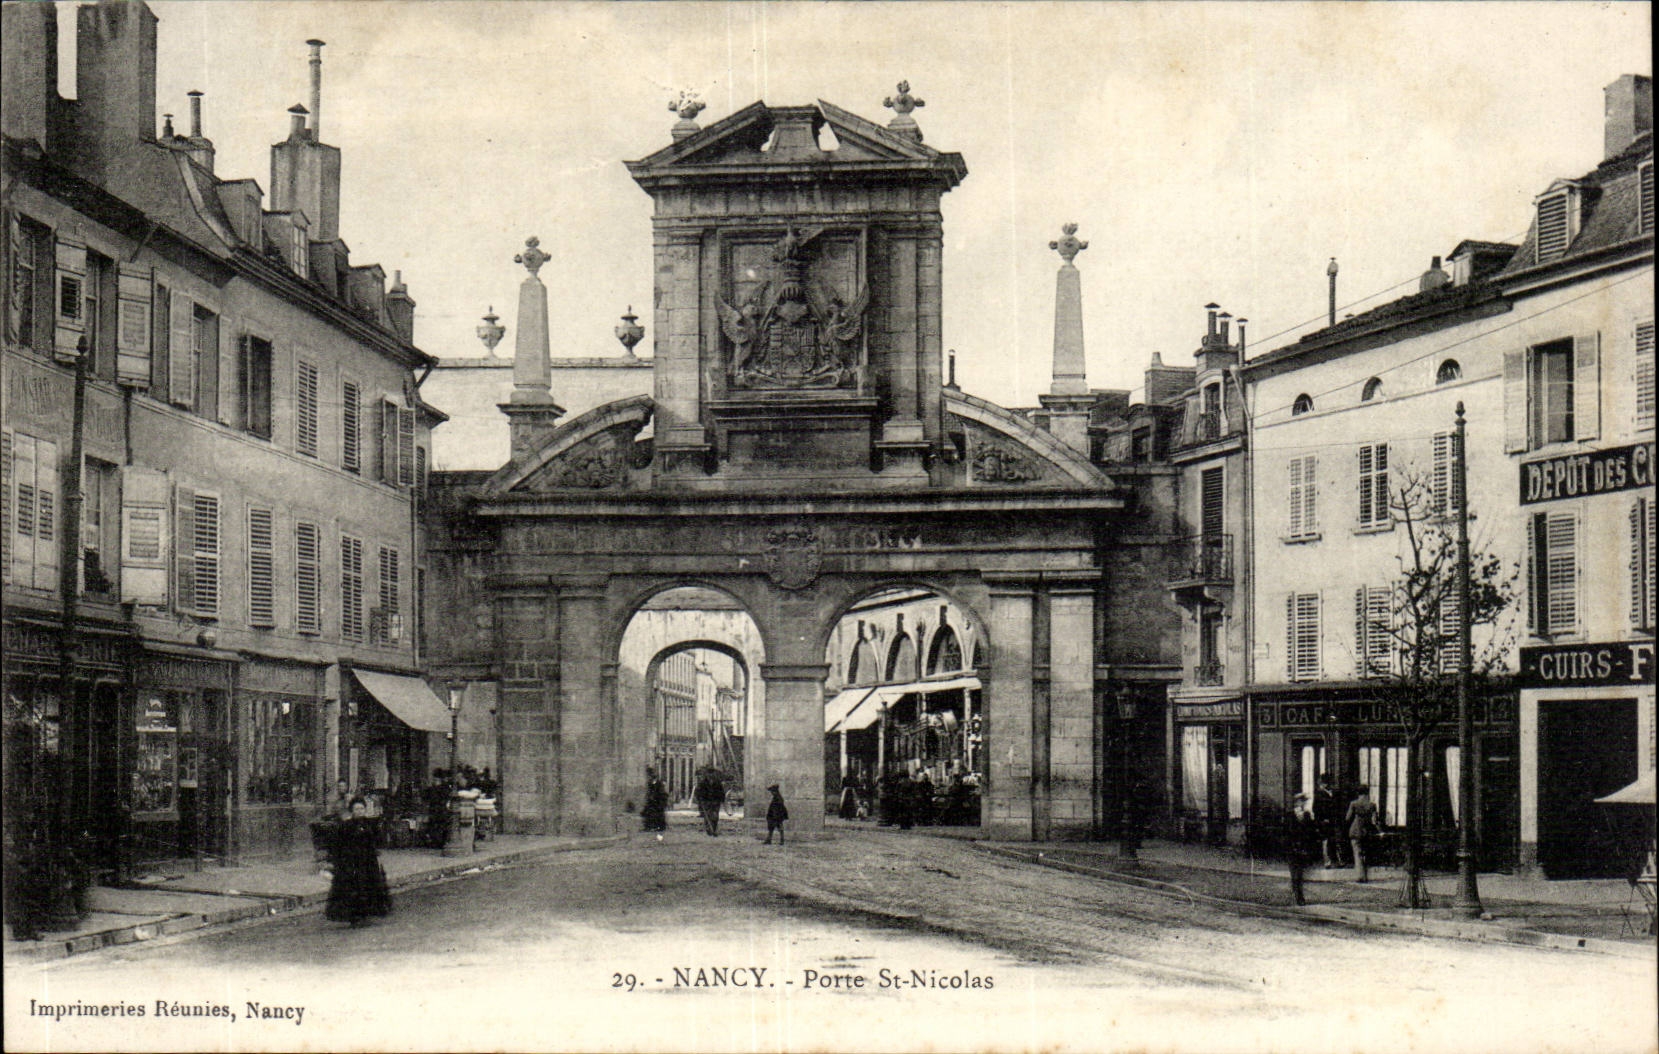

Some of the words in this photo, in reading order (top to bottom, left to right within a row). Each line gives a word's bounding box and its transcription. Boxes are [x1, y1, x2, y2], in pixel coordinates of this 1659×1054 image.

[1594, 456, 1627, 491] DES
[1540, 650, 1611, 680] CUIRS
[1286, 706, 1338, 723] CAF
